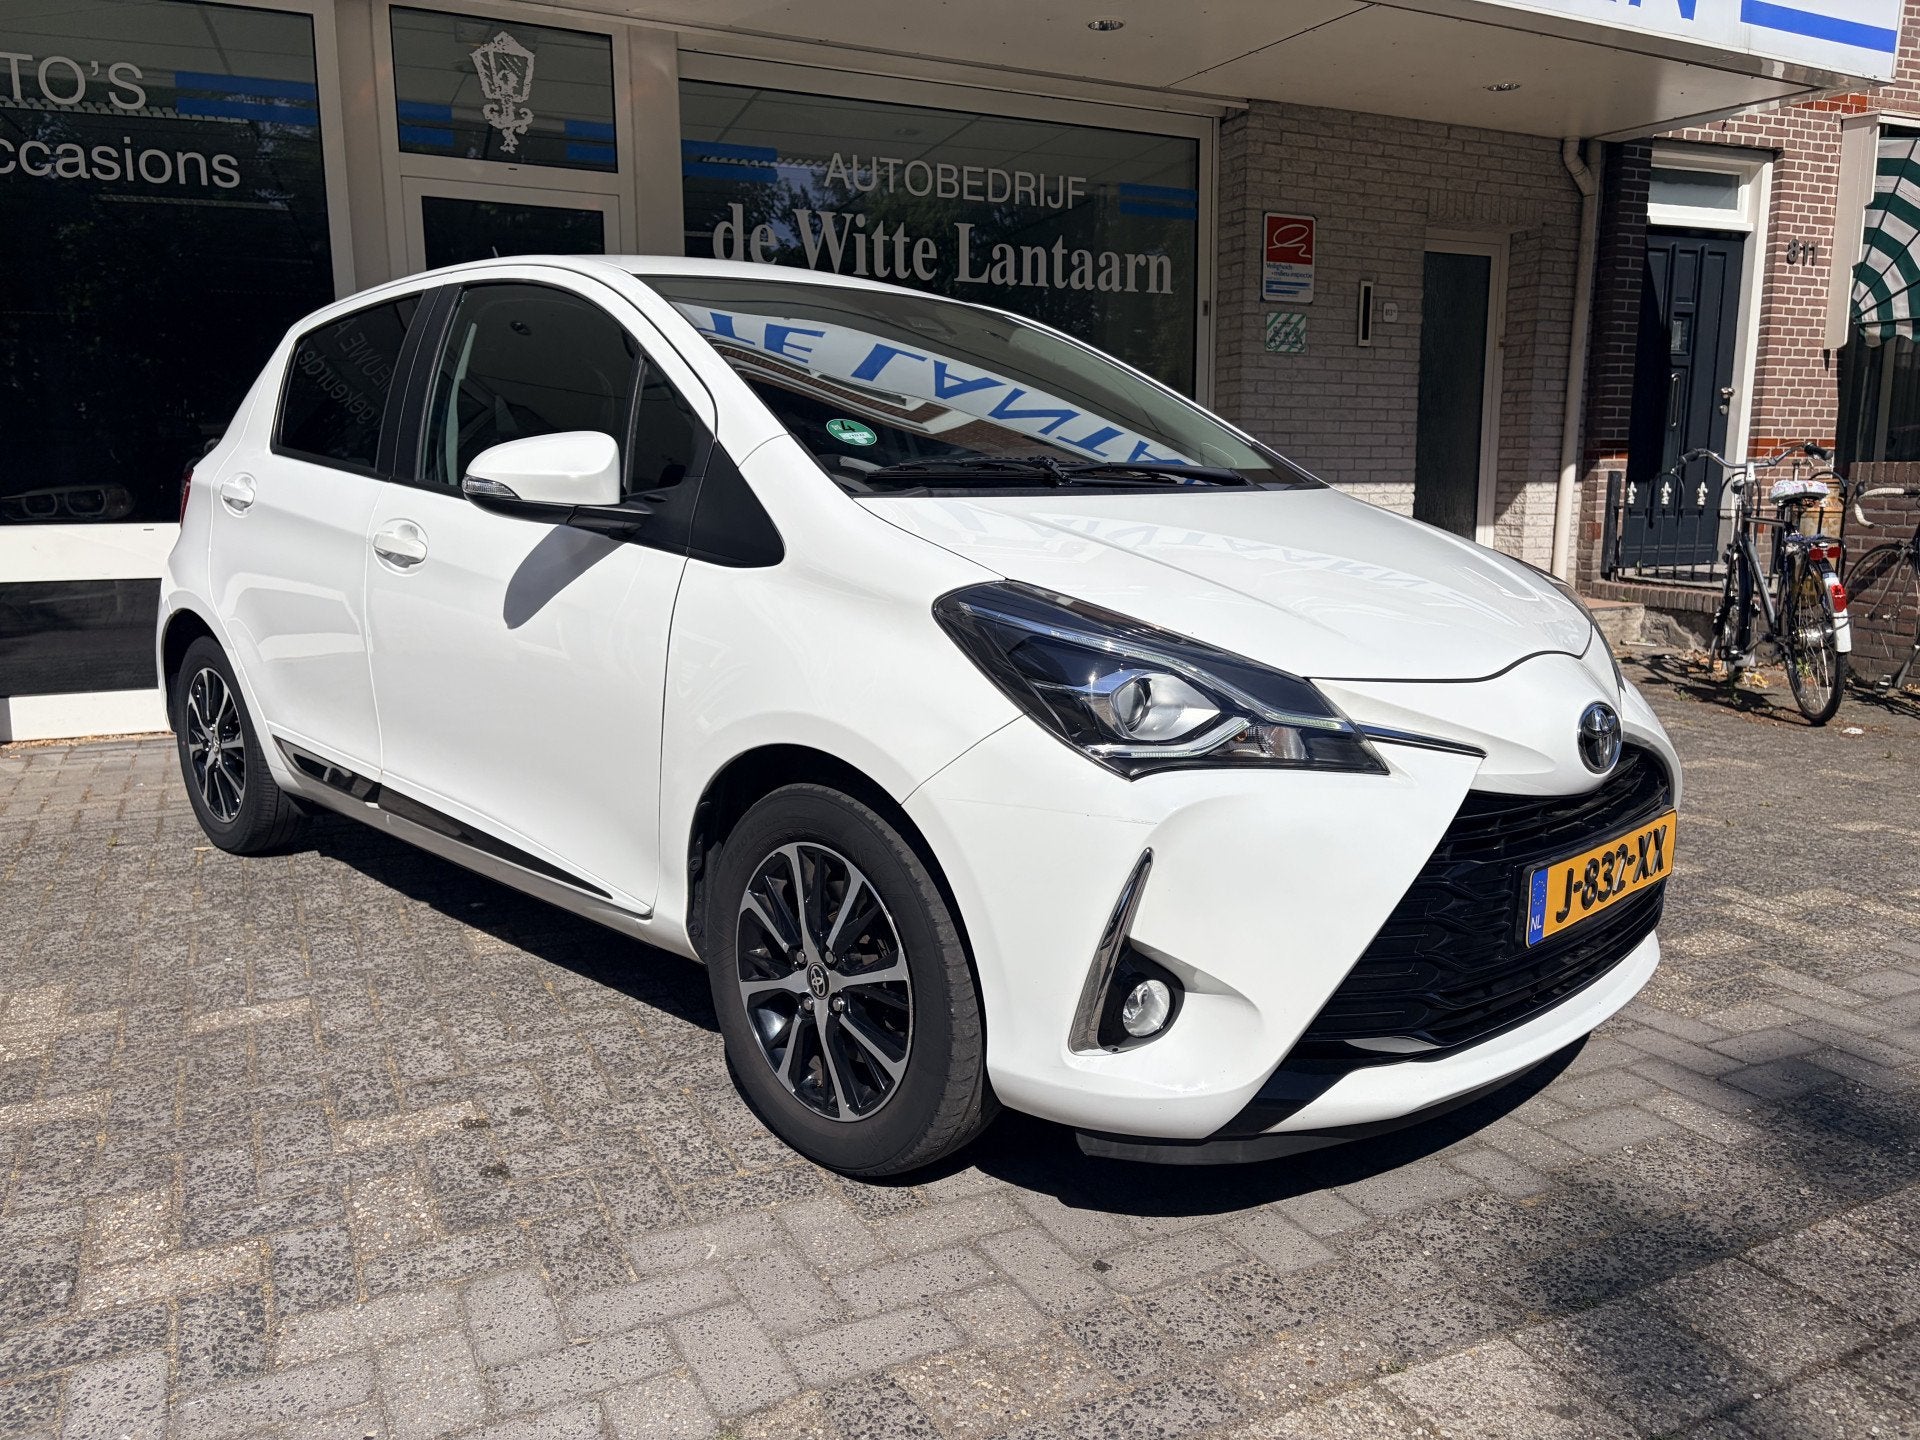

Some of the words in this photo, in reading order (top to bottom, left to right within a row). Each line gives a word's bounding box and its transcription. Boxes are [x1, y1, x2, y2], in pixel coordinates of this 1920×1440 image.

[824, 152, 1087, 209] AUTOBEDRIJF
[712, 202, 778, 266] de
[792, 208, 939, 281] Witte
[953, 222, 1174, 294] Lantaarn
[1786, 239, 1819, 267] 811
[1530, 916, 1542, 933] NL
[1556, 825, 1667, 923] J-832-XX
